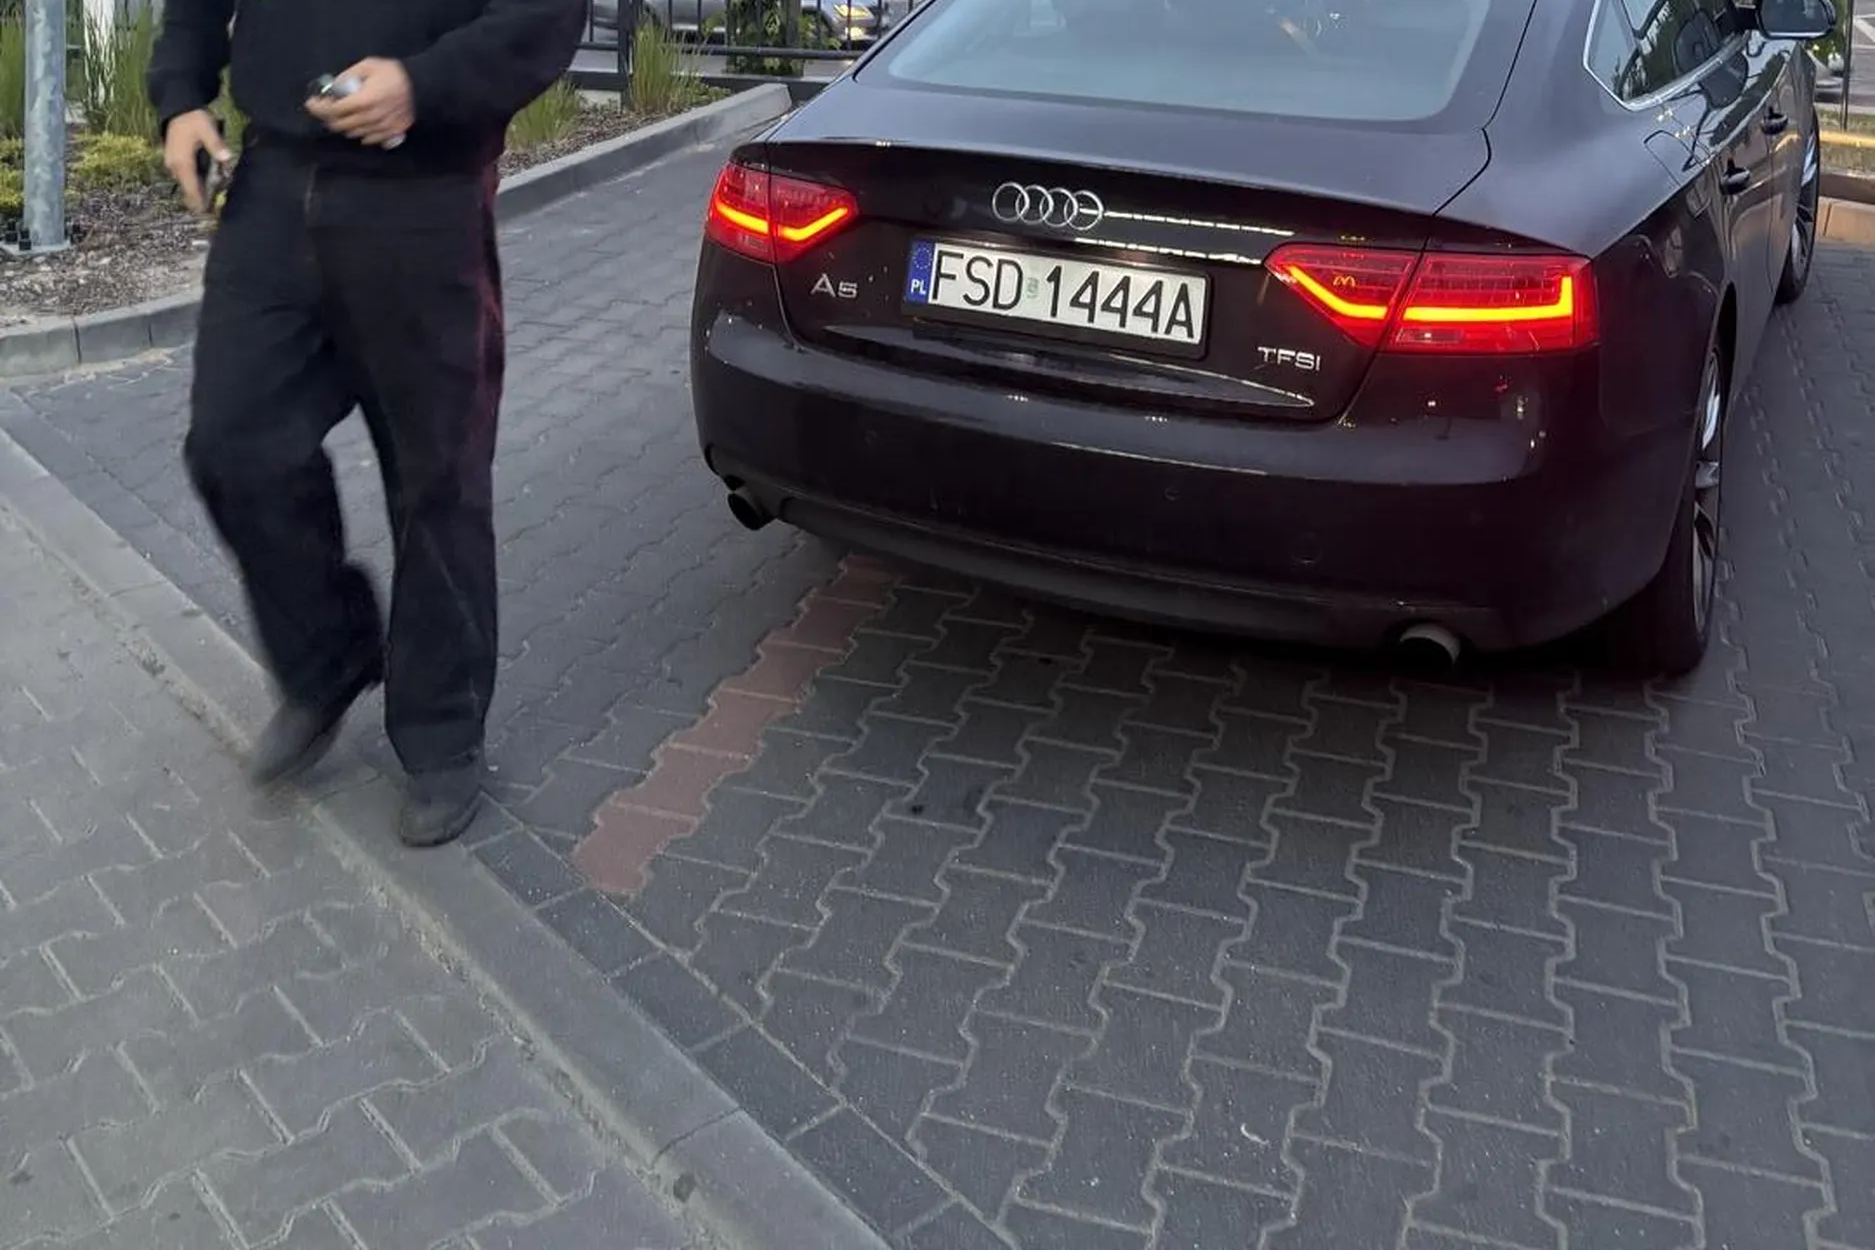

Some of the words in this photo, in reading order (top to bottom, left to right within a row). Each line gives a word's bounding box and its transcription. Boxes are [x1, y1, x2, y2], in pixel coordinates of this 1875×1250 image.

[810, 273, 858, 299] A5
[910, 278, 927, 296] PL
[932, 250, 1024, 310] FSD
[1046, 265, 1195, 339] 1444A
[1257, 346, 1321, 371] TFSI
